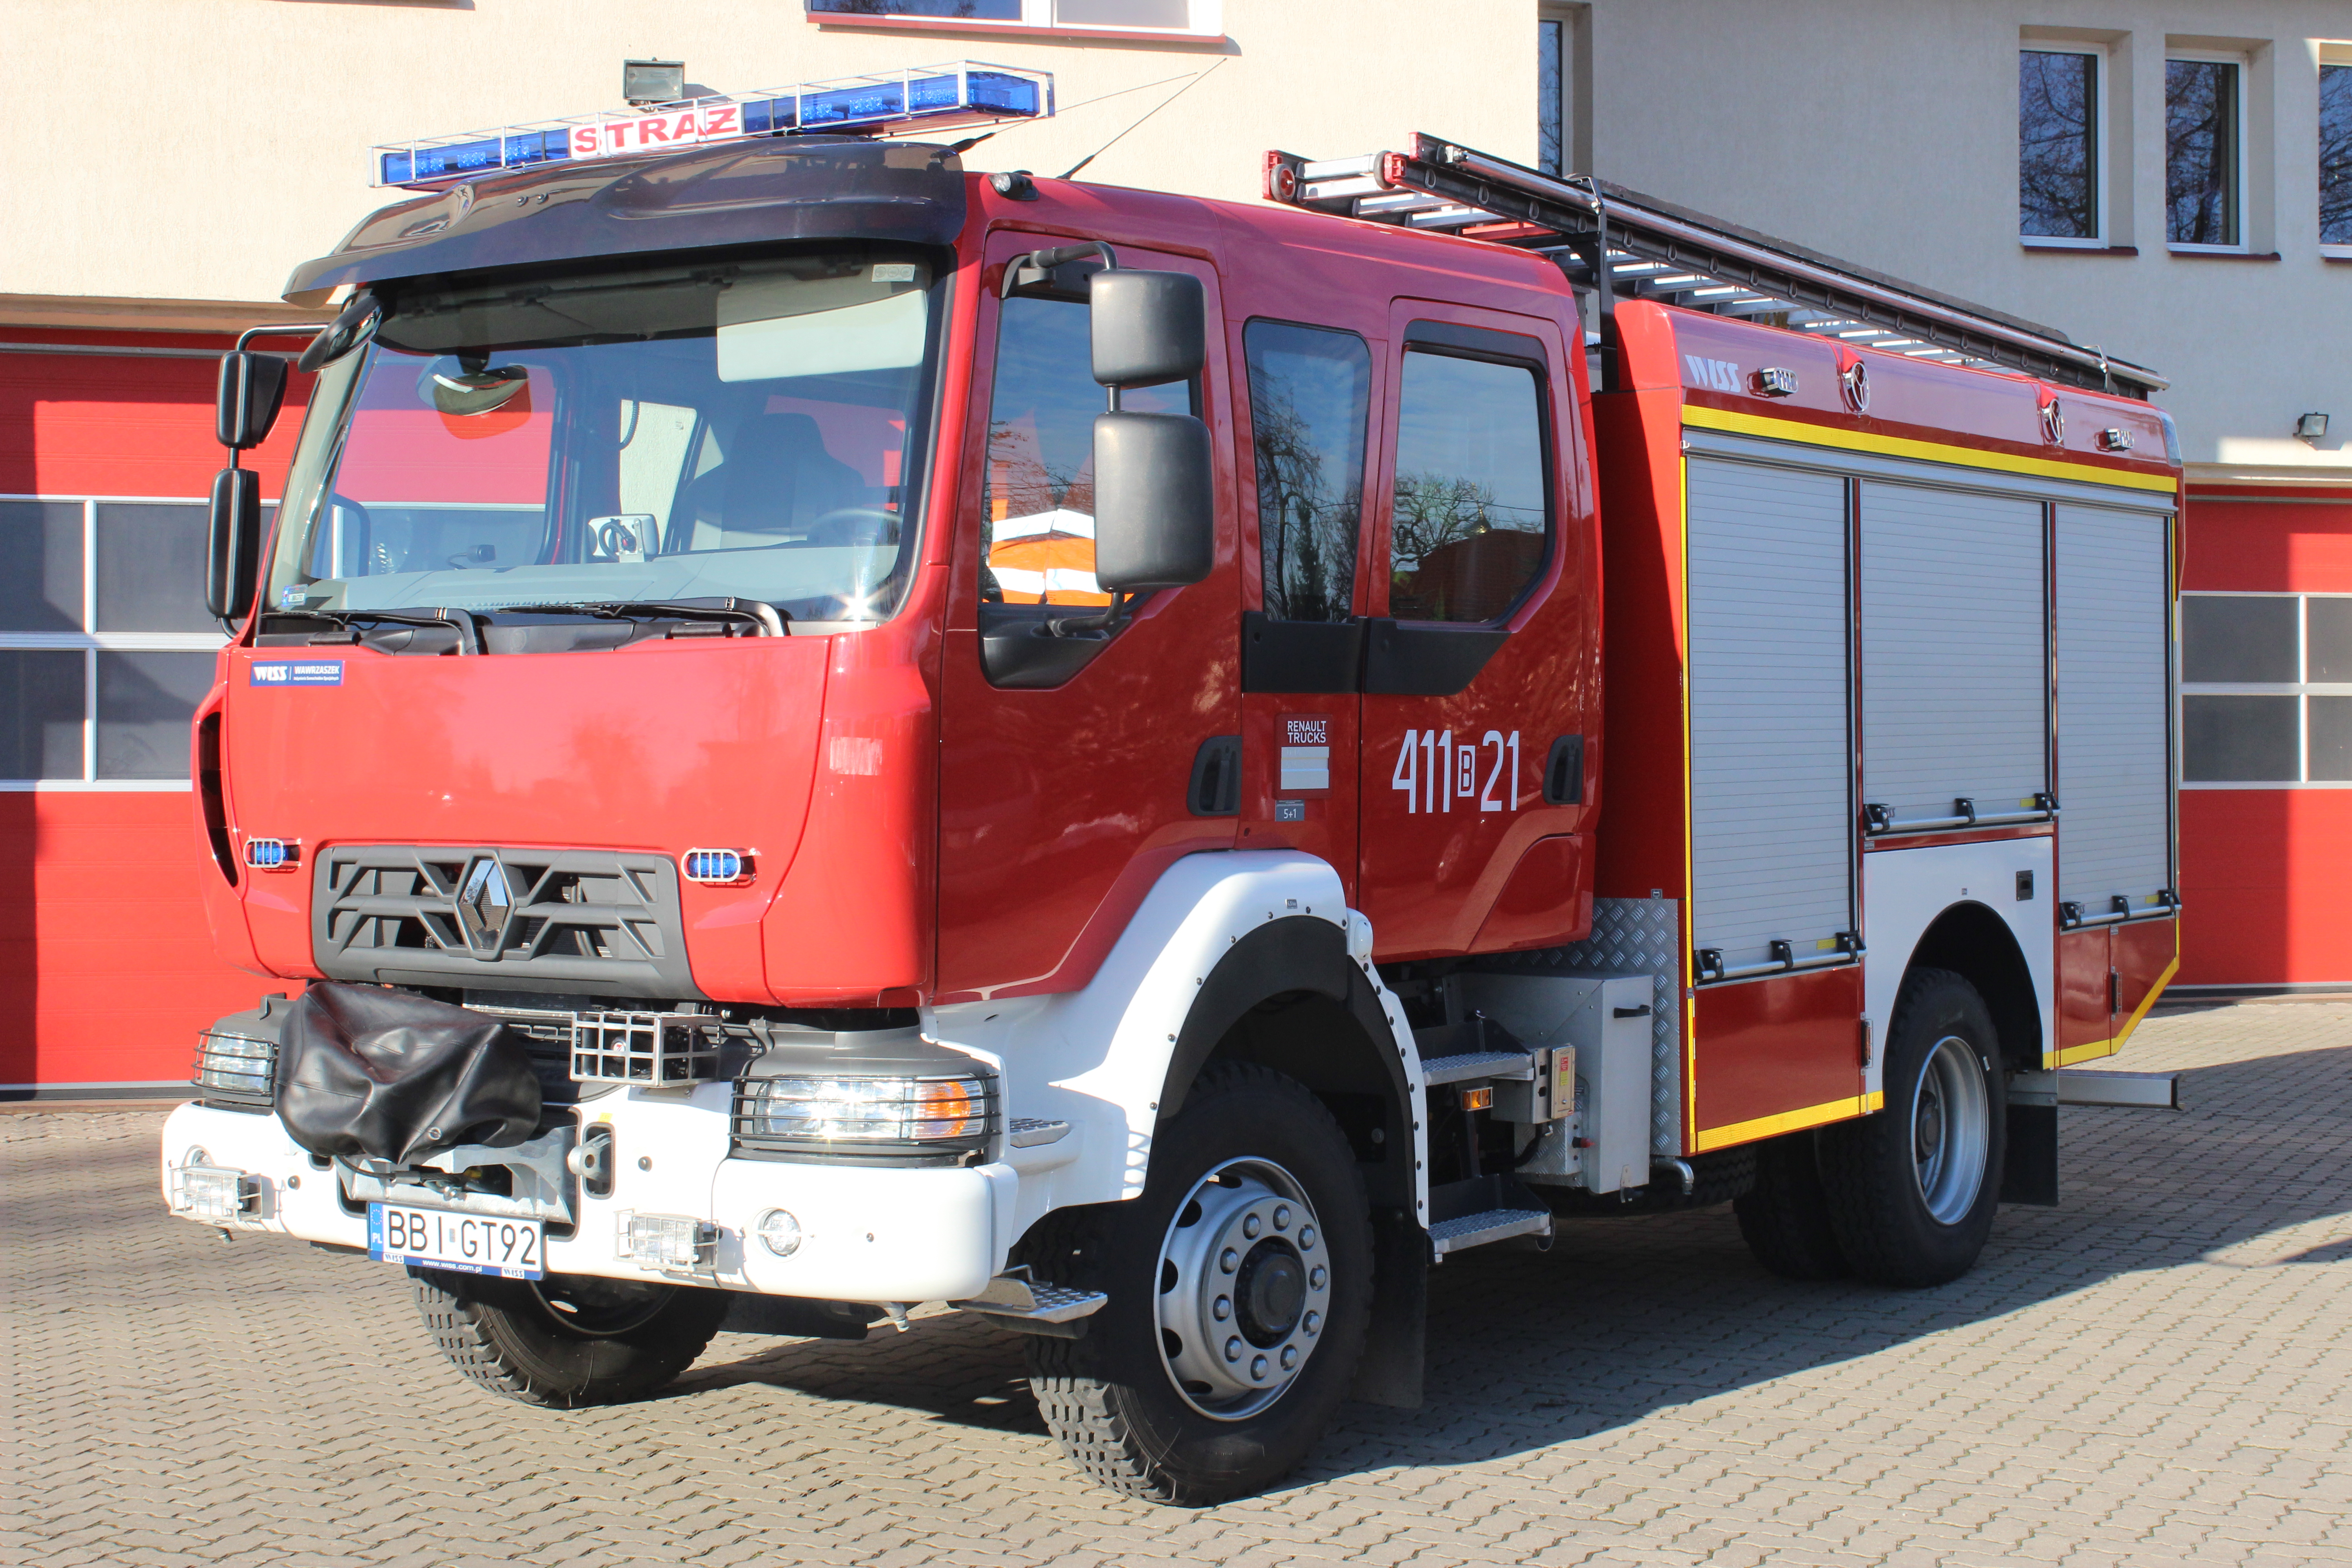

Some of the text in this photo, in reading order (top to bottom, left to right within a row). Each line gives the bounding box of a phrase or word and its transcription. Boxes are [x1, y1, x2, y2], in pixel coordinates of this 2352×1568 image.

[1685, 354, 1741, 393] WISS
[253, 666, 288, 681] WISS
[294, 666, 340, 674] WAWRZASZEK
[1287, 720, 1327, 732] RENAULT
[1287, 732, 1326, 744] TRUCKS
[1284, 808, 1297, 819] 5+1
[372, 1232, 382, 1244] PL
[388, 1210, 536, 1265] BBI GT92
[384, 1253, 403, 1263] WISS
[422, 1259, 482, 1273] www.wiss.com.pl
[503, 1268, 523, 1277] WISS
